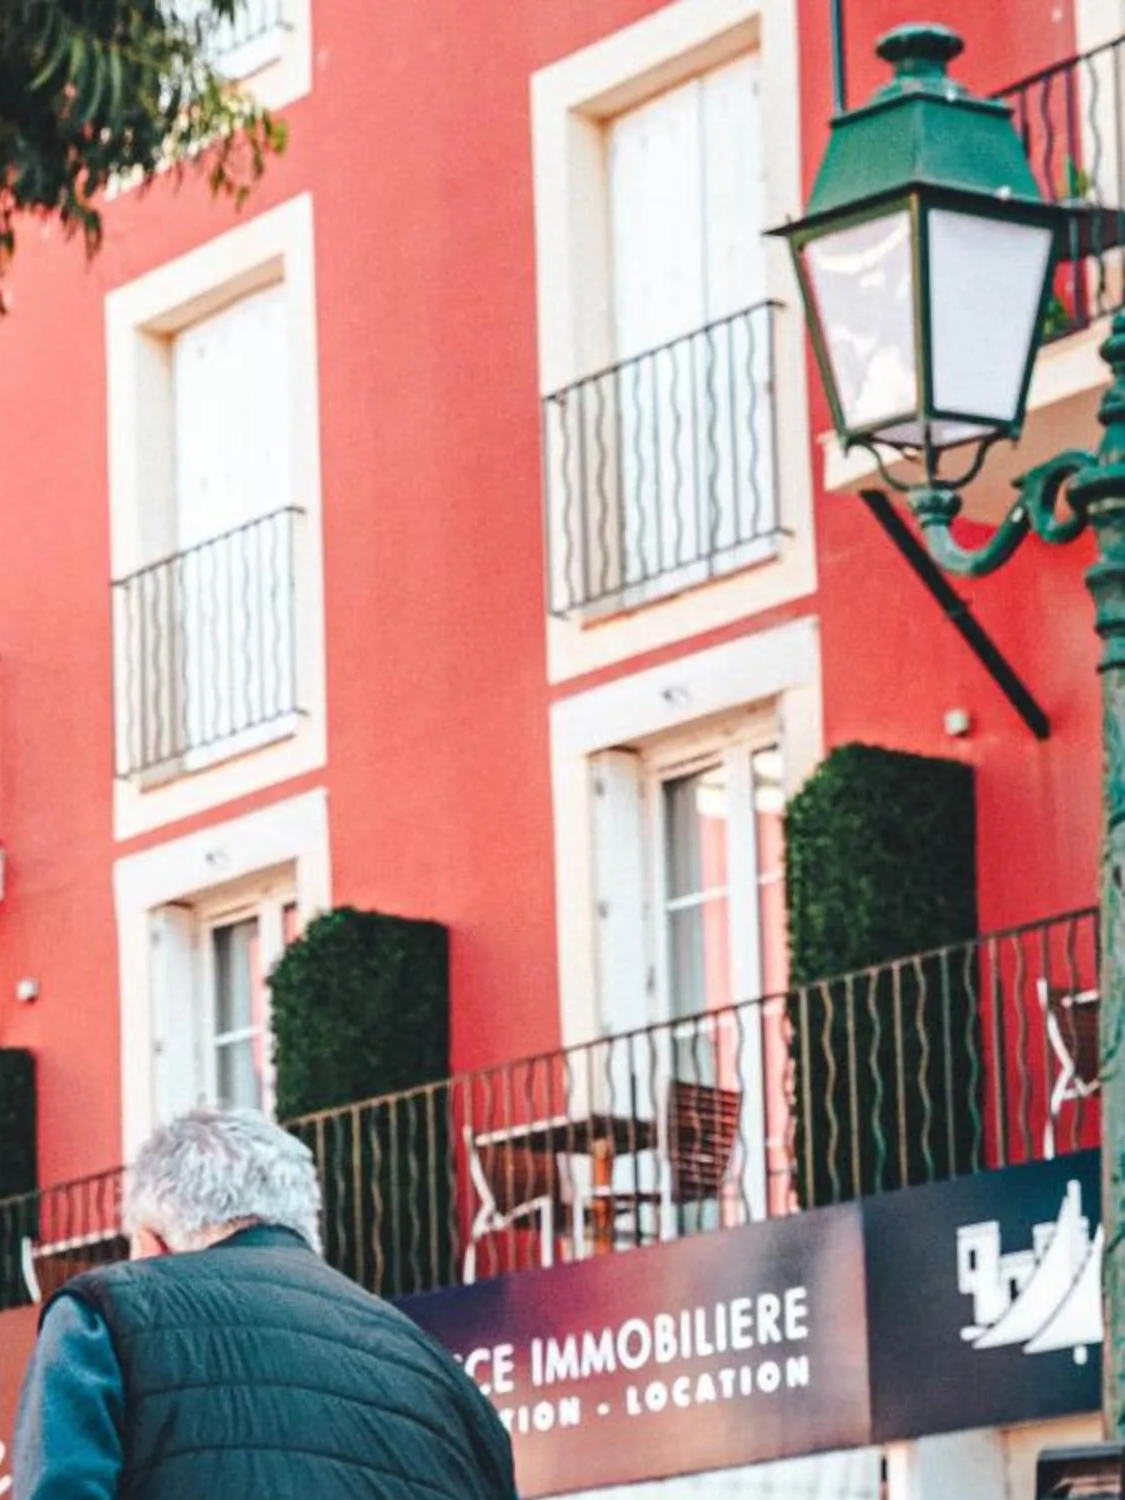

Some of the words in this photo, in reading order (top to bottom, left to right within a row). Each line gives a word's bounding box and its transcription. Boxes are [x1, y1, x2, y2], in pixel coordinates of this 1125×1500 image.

[453, 1343, 515, 1396] CE
[531, 1286, 809, 1387] IMMOBILIERE
[626, 1355, 810, 1416] LOCATION
